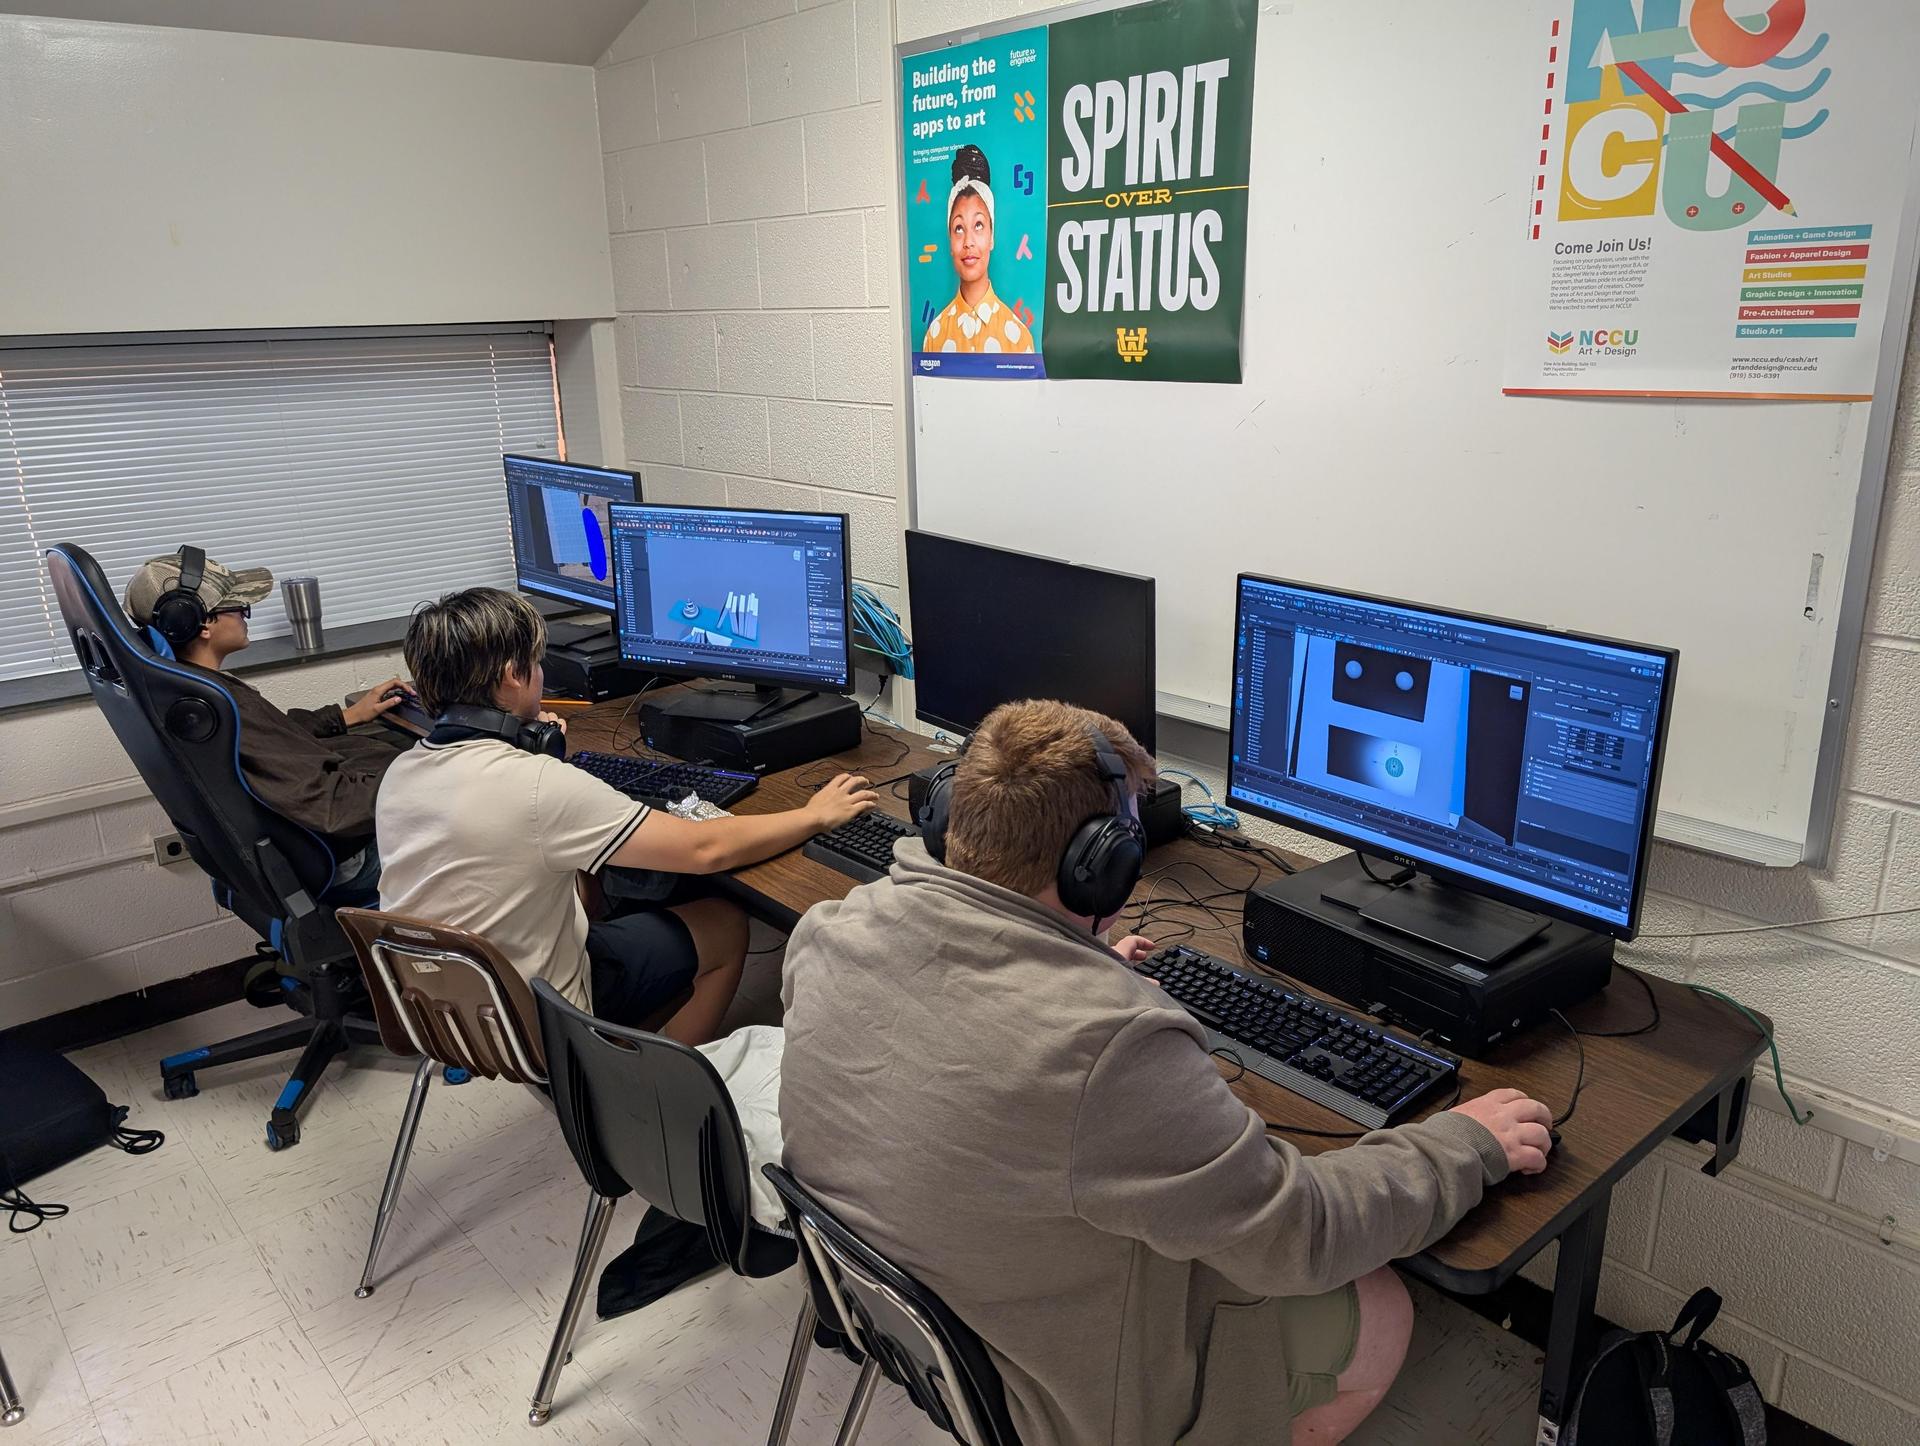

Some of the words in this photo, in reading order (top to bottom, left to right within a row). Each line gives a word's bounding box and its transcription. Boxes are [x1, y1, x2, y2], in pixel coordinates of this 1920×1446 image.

[1010, 49, 1030, 60] future
[1009, 55, 1037, 67] engineer
[912, 62, 969, 89] Building
[971, 56, 996, 76] the
[912, 91, 958, 112] future,
[961, 84, 996, 104] from
[912, 118, 944, 139] apps
[946, 115, 961, 130] to
[964, 109, 986, 128] art
[1061, 58, 1230, 192] SPIRIT
[930, 146, 949, 154] computer
[929, 154, 949, 162] classroom
[1104, 188, 1172, 209] OVER
[1752, 234, 1793, 242] Animation
[1802, 231, 1826, 239] Game
[1827, 230, 1856, 239] Design
[1554, 242, 1593, 255] Come
[1596, 239, 1624, 253] Join
[1628, 237, 1651, 251] Us!
[1750, 252, 1781, 260] Fashion
[1789, 250, 1821, 259] Apparel
[1822, 249, 1851, 258] Design
[1057, 209, 1222, 314] STATUS
[1762, 271, 1792, 279] Studies
[1745, 290, 1776, 299] Graphic
[1777, 289, 1805, 298] Design
[1814, 288, 1858, 297] Innovation
[1743, 309, 1815, 317] Pre-Architecture
[1740, 327, 1768, 335] Studio
[1769, 327, 1783, 335] Art
[1579, 329, 1639, 346] NCCU
[1578, 347, 1592, 355] Art
[1604, 347, 1637, 357] Design
[920, 359, 941, 368] amazon
[1732, 356, 1818, 364] www.nccu.edu/cash/art
[1730, 364, 1817, 372] artanddesign@nccu.edu
